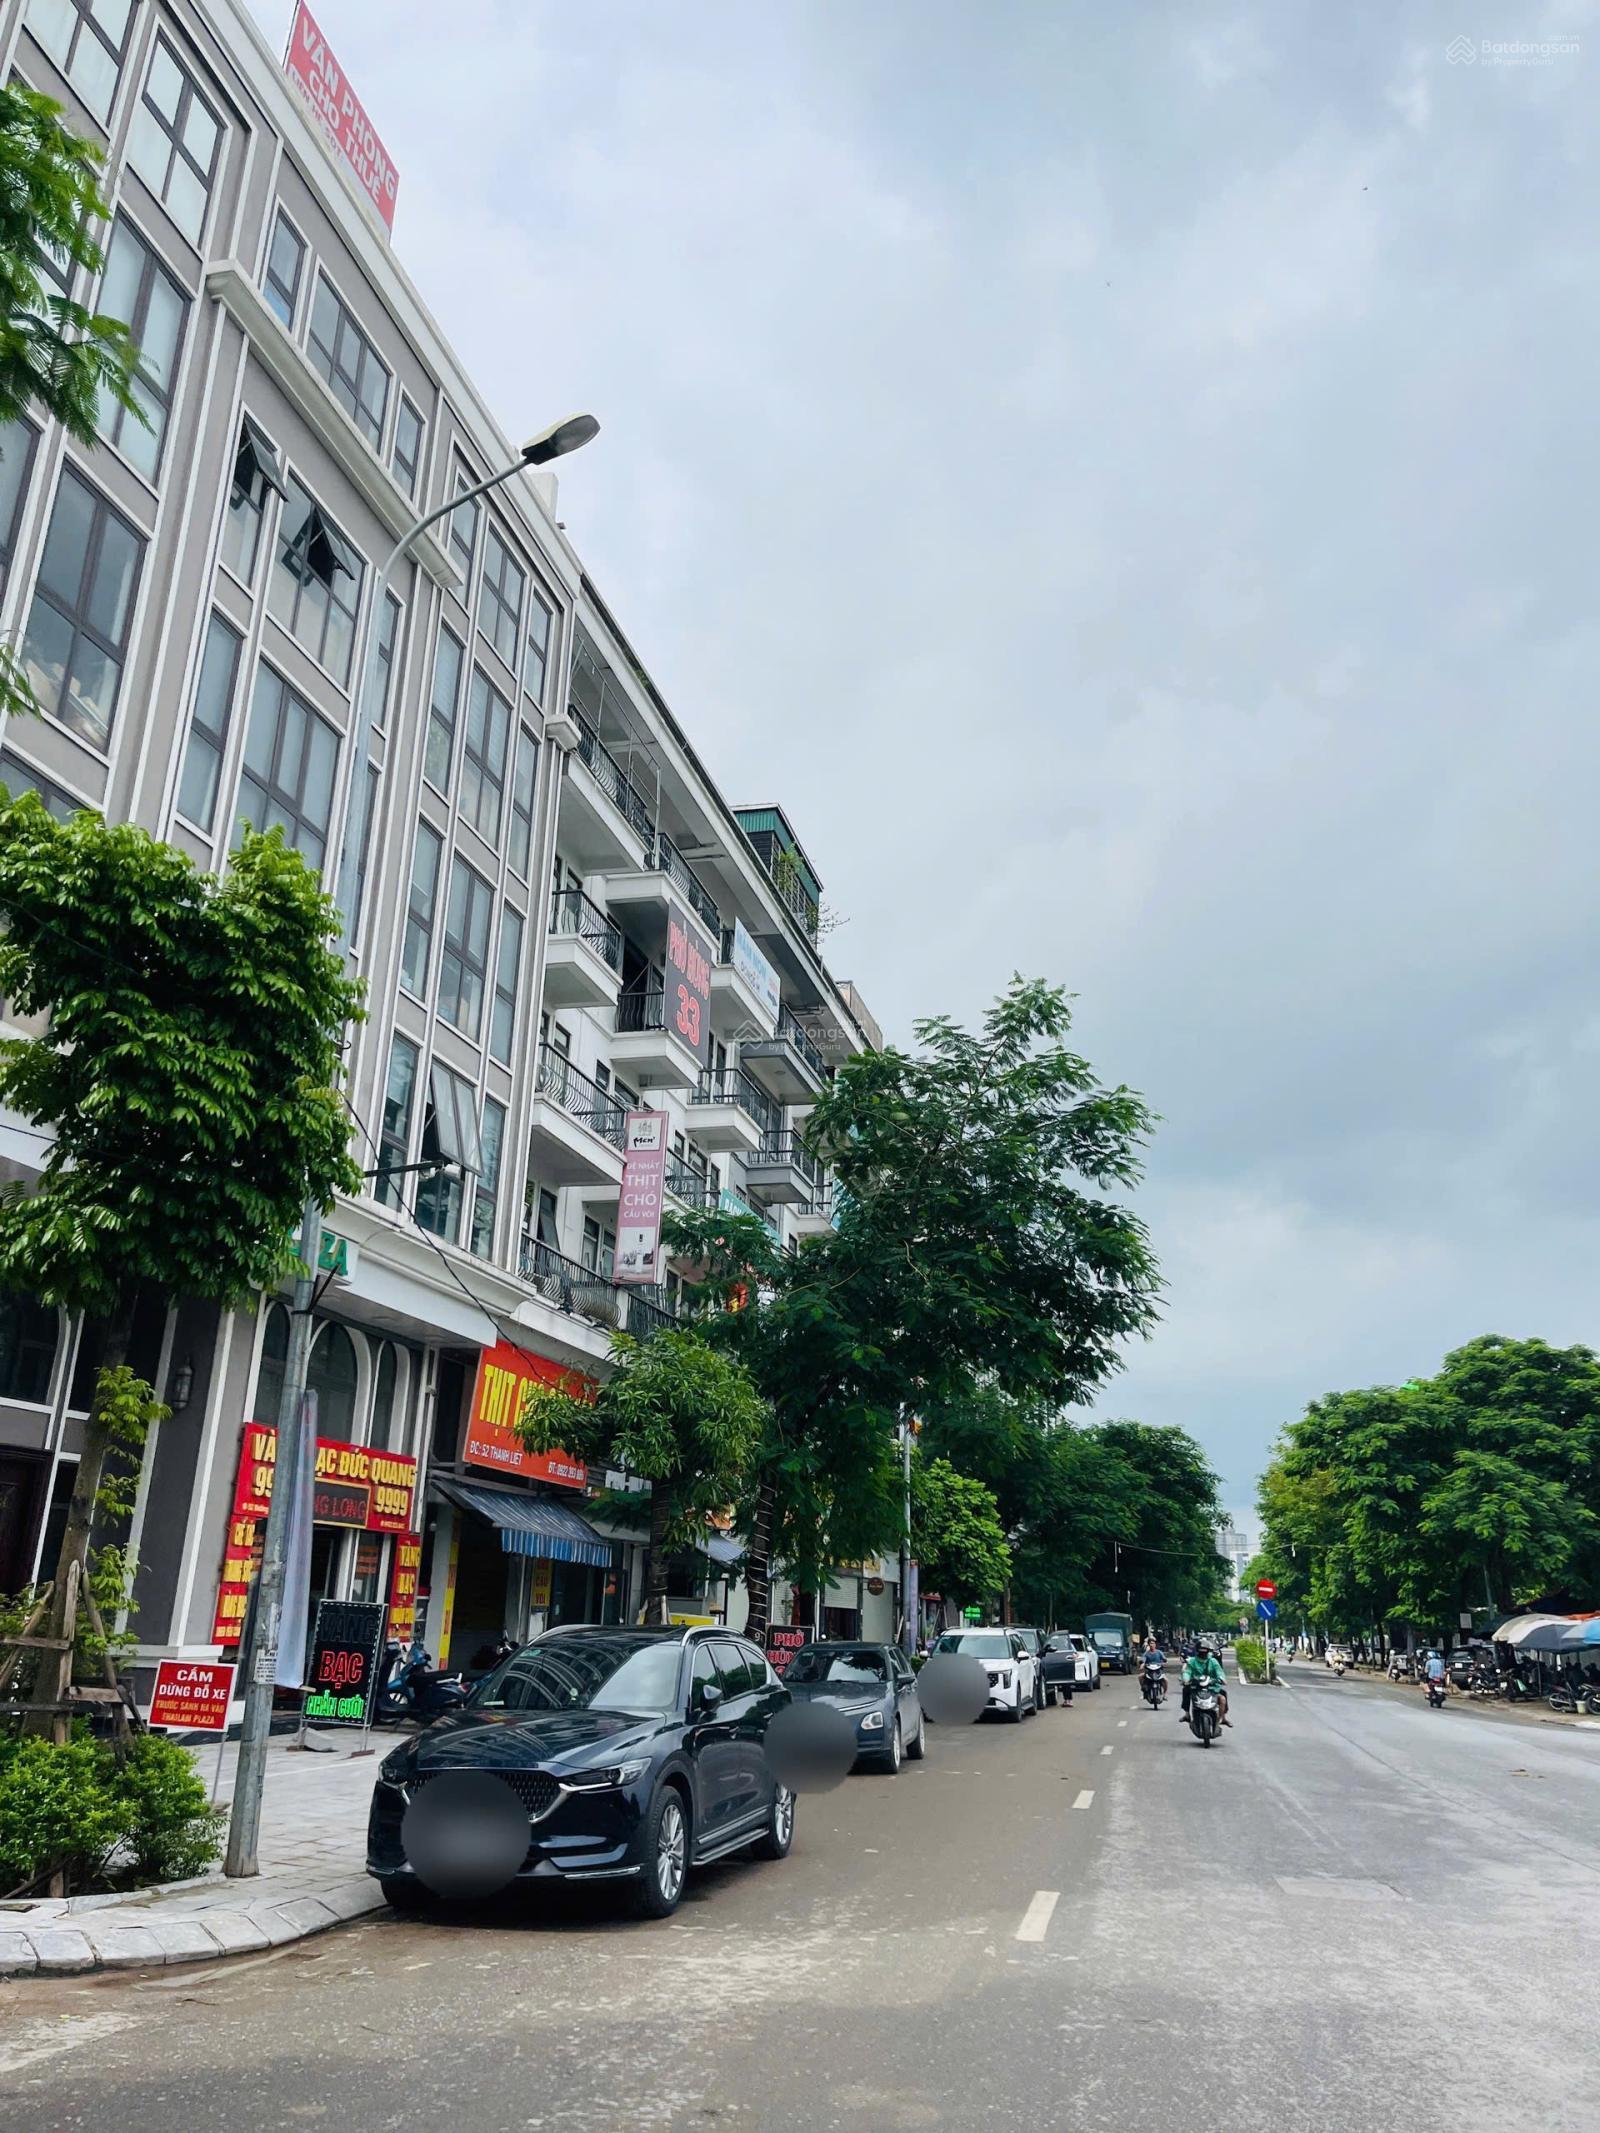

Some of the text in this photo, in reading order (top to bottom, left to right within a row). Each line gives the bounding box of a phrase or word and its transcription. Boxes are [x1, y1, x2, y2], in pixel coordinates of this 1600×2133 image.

[303, 17, 339, 96] VĂN
[309, 69, 381, 203] CHO THUÊ
[677, 983, 700, 1046] 33
[626, 1174, 660, 1190] THỊT
[624, 1191, 657, 1206] CHÓ
[480, 1363, 517, 1437] THỊT
[254, 1429, 417, 1489] VÀ ẠC ĐỨC QUANG
[482, 1443, 489, 1458] 52
[376, 1485, 409, 1517] 9999
[773, 1629, 805, 1647] PHỞ
[767, 1647, 794, 1664] HÙN
[176, 1666, 214, 1683] CẤM
[318, 1650, 364, 1689] BẠC
[159, 1682, 228, 1700] DỪNG ĐỖ XE
[306, 1689, 365, 1719] NHẪN CƯỚI
[192, 1714, 215, 1725] PLAZA
